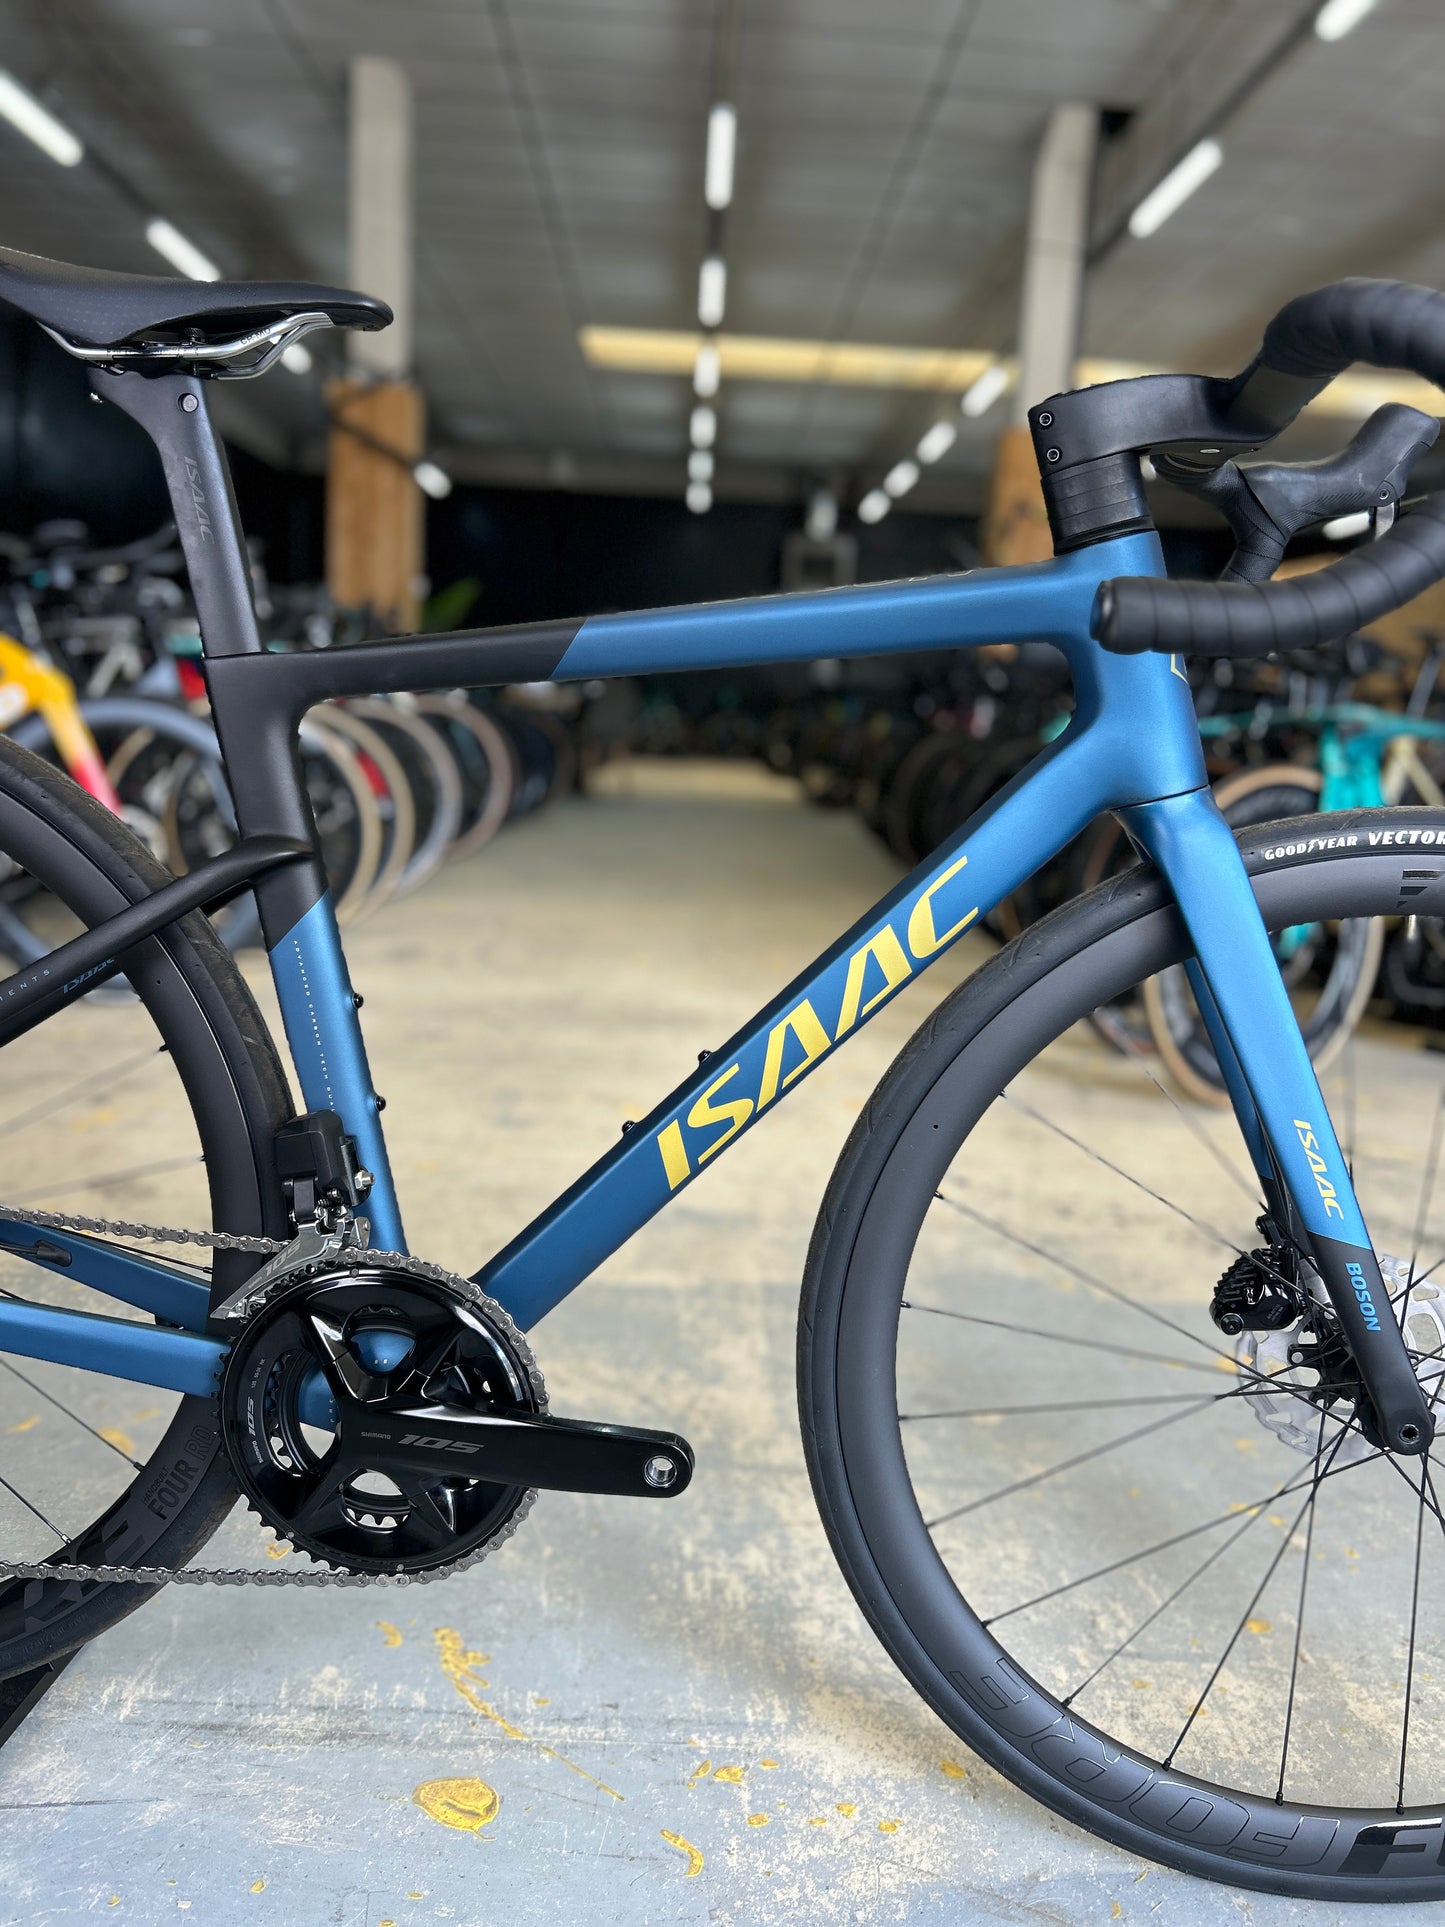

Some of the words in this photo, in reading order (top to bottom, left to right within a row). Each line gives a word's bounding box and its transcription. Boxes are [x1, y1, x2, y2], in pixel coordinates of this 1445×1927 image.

[184, 456, 216, 545] ISAAC
[1264, 835, 1358, 861] GOODYEAR
[293, 940, 311, 996] ADVANCED
[308, 1003, 321, 1046] CARBON
[319, 1053, 329, 1080] TECH
[326, 1087, 335, 1112] QUAL
[657, 855, 978, 1191] ISAAC
[1293, 1119, 1345, 1220] ISAAC
[265, 1241, 301, 1276] 105
[1345, 1262, 1382, 1332] BOSON
[247, 1396, 256, 1437] 105
[361, 1431, 391, 1440] SHIMANO
[398, 1433, 485, 1454] 105
[147, 1459, 200, 1520] FOUR
[184, 1424, 213, 1461] RD
